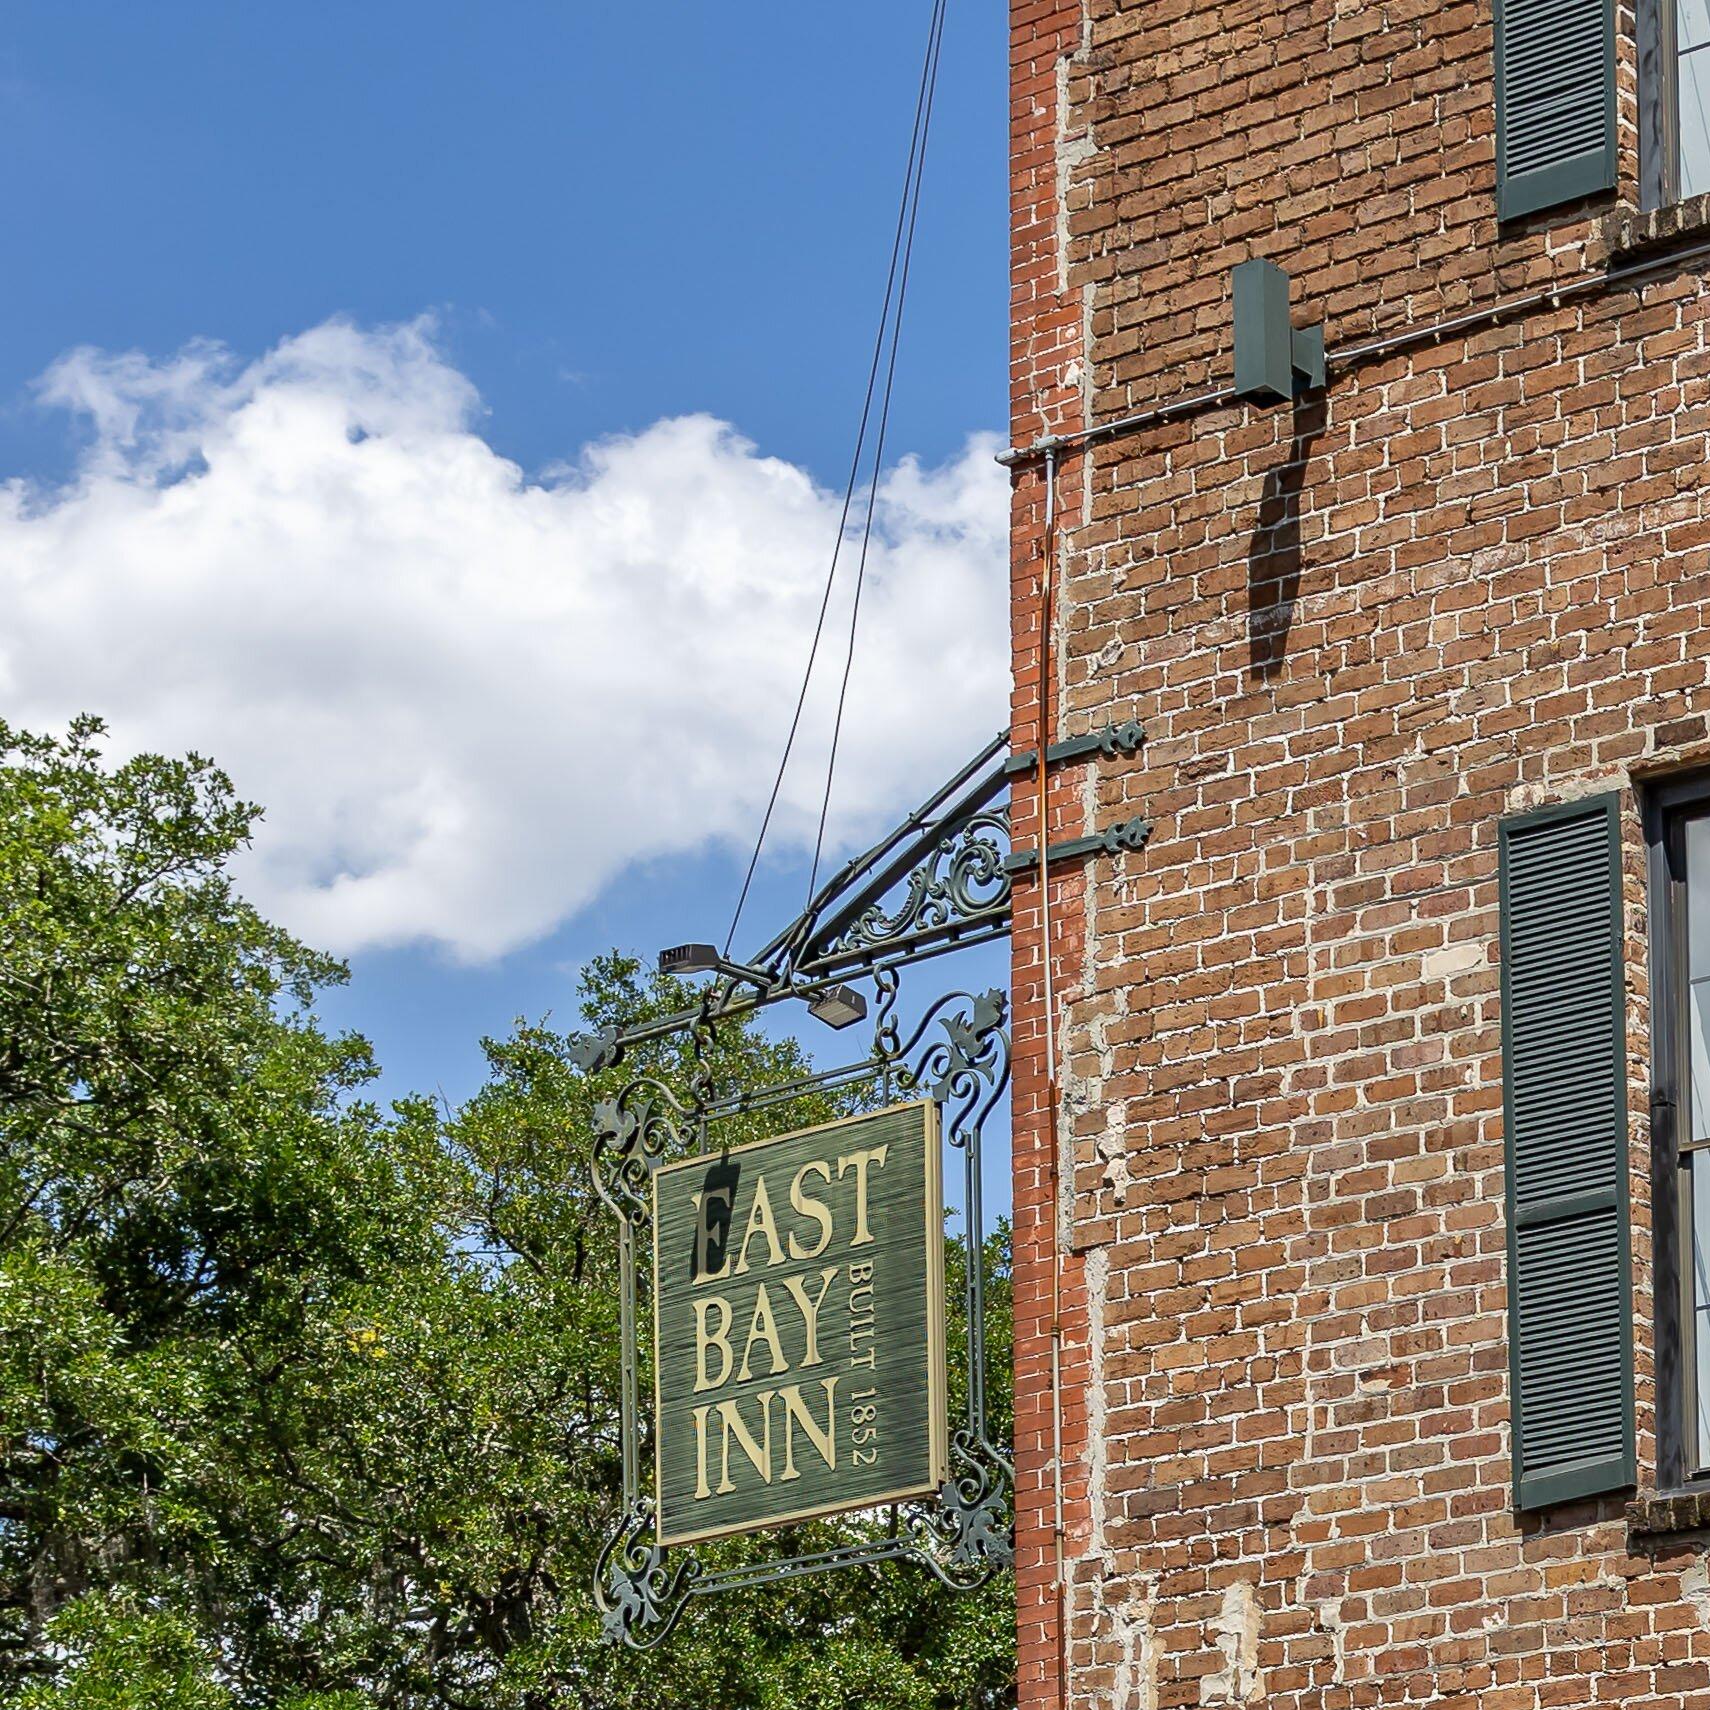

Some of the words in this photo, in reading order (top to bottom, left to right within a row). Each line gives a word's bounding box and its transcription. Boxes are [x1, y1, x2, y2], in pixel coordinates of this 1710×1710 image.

[691, 1143, 889, 1287] EAST
[692, 1268, 839, 1394] BAY
[849, 1259, 876, 1371] BUILT
[692, 1376, 840, 1501] INN
[850, 1387, 878, 1467] 1852
